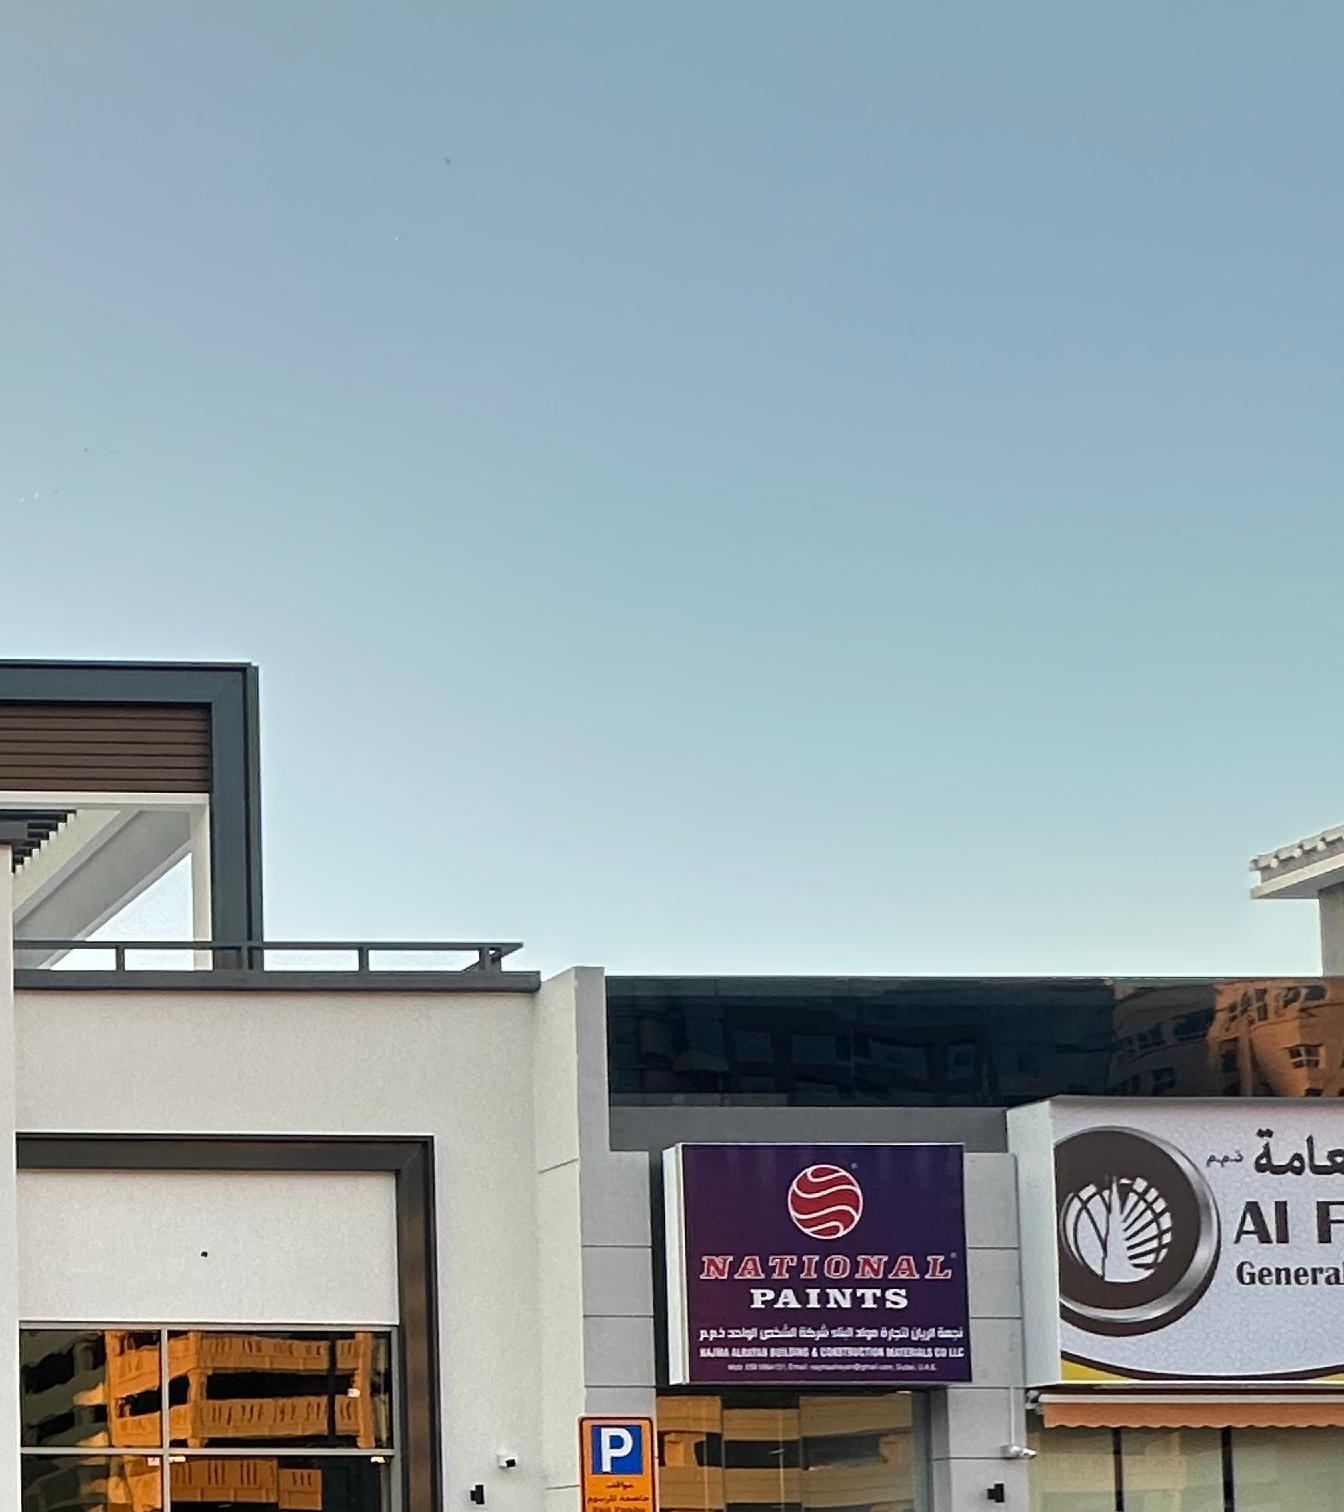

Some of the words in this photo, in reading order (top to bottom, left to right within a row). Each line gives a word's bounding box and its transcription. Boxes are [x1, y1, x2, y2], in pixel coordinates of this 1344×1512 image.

[1233, 1200, 1290, 1245] Al
[699, 1254, 953, 1280] NATIONAL
[1235, 1260, 1344, 1286] Genera
[749, 1287, 909, 1309] PAINTS
[811, 1347, 818, 1358] &
[600, 1427, 633, 1473] P
